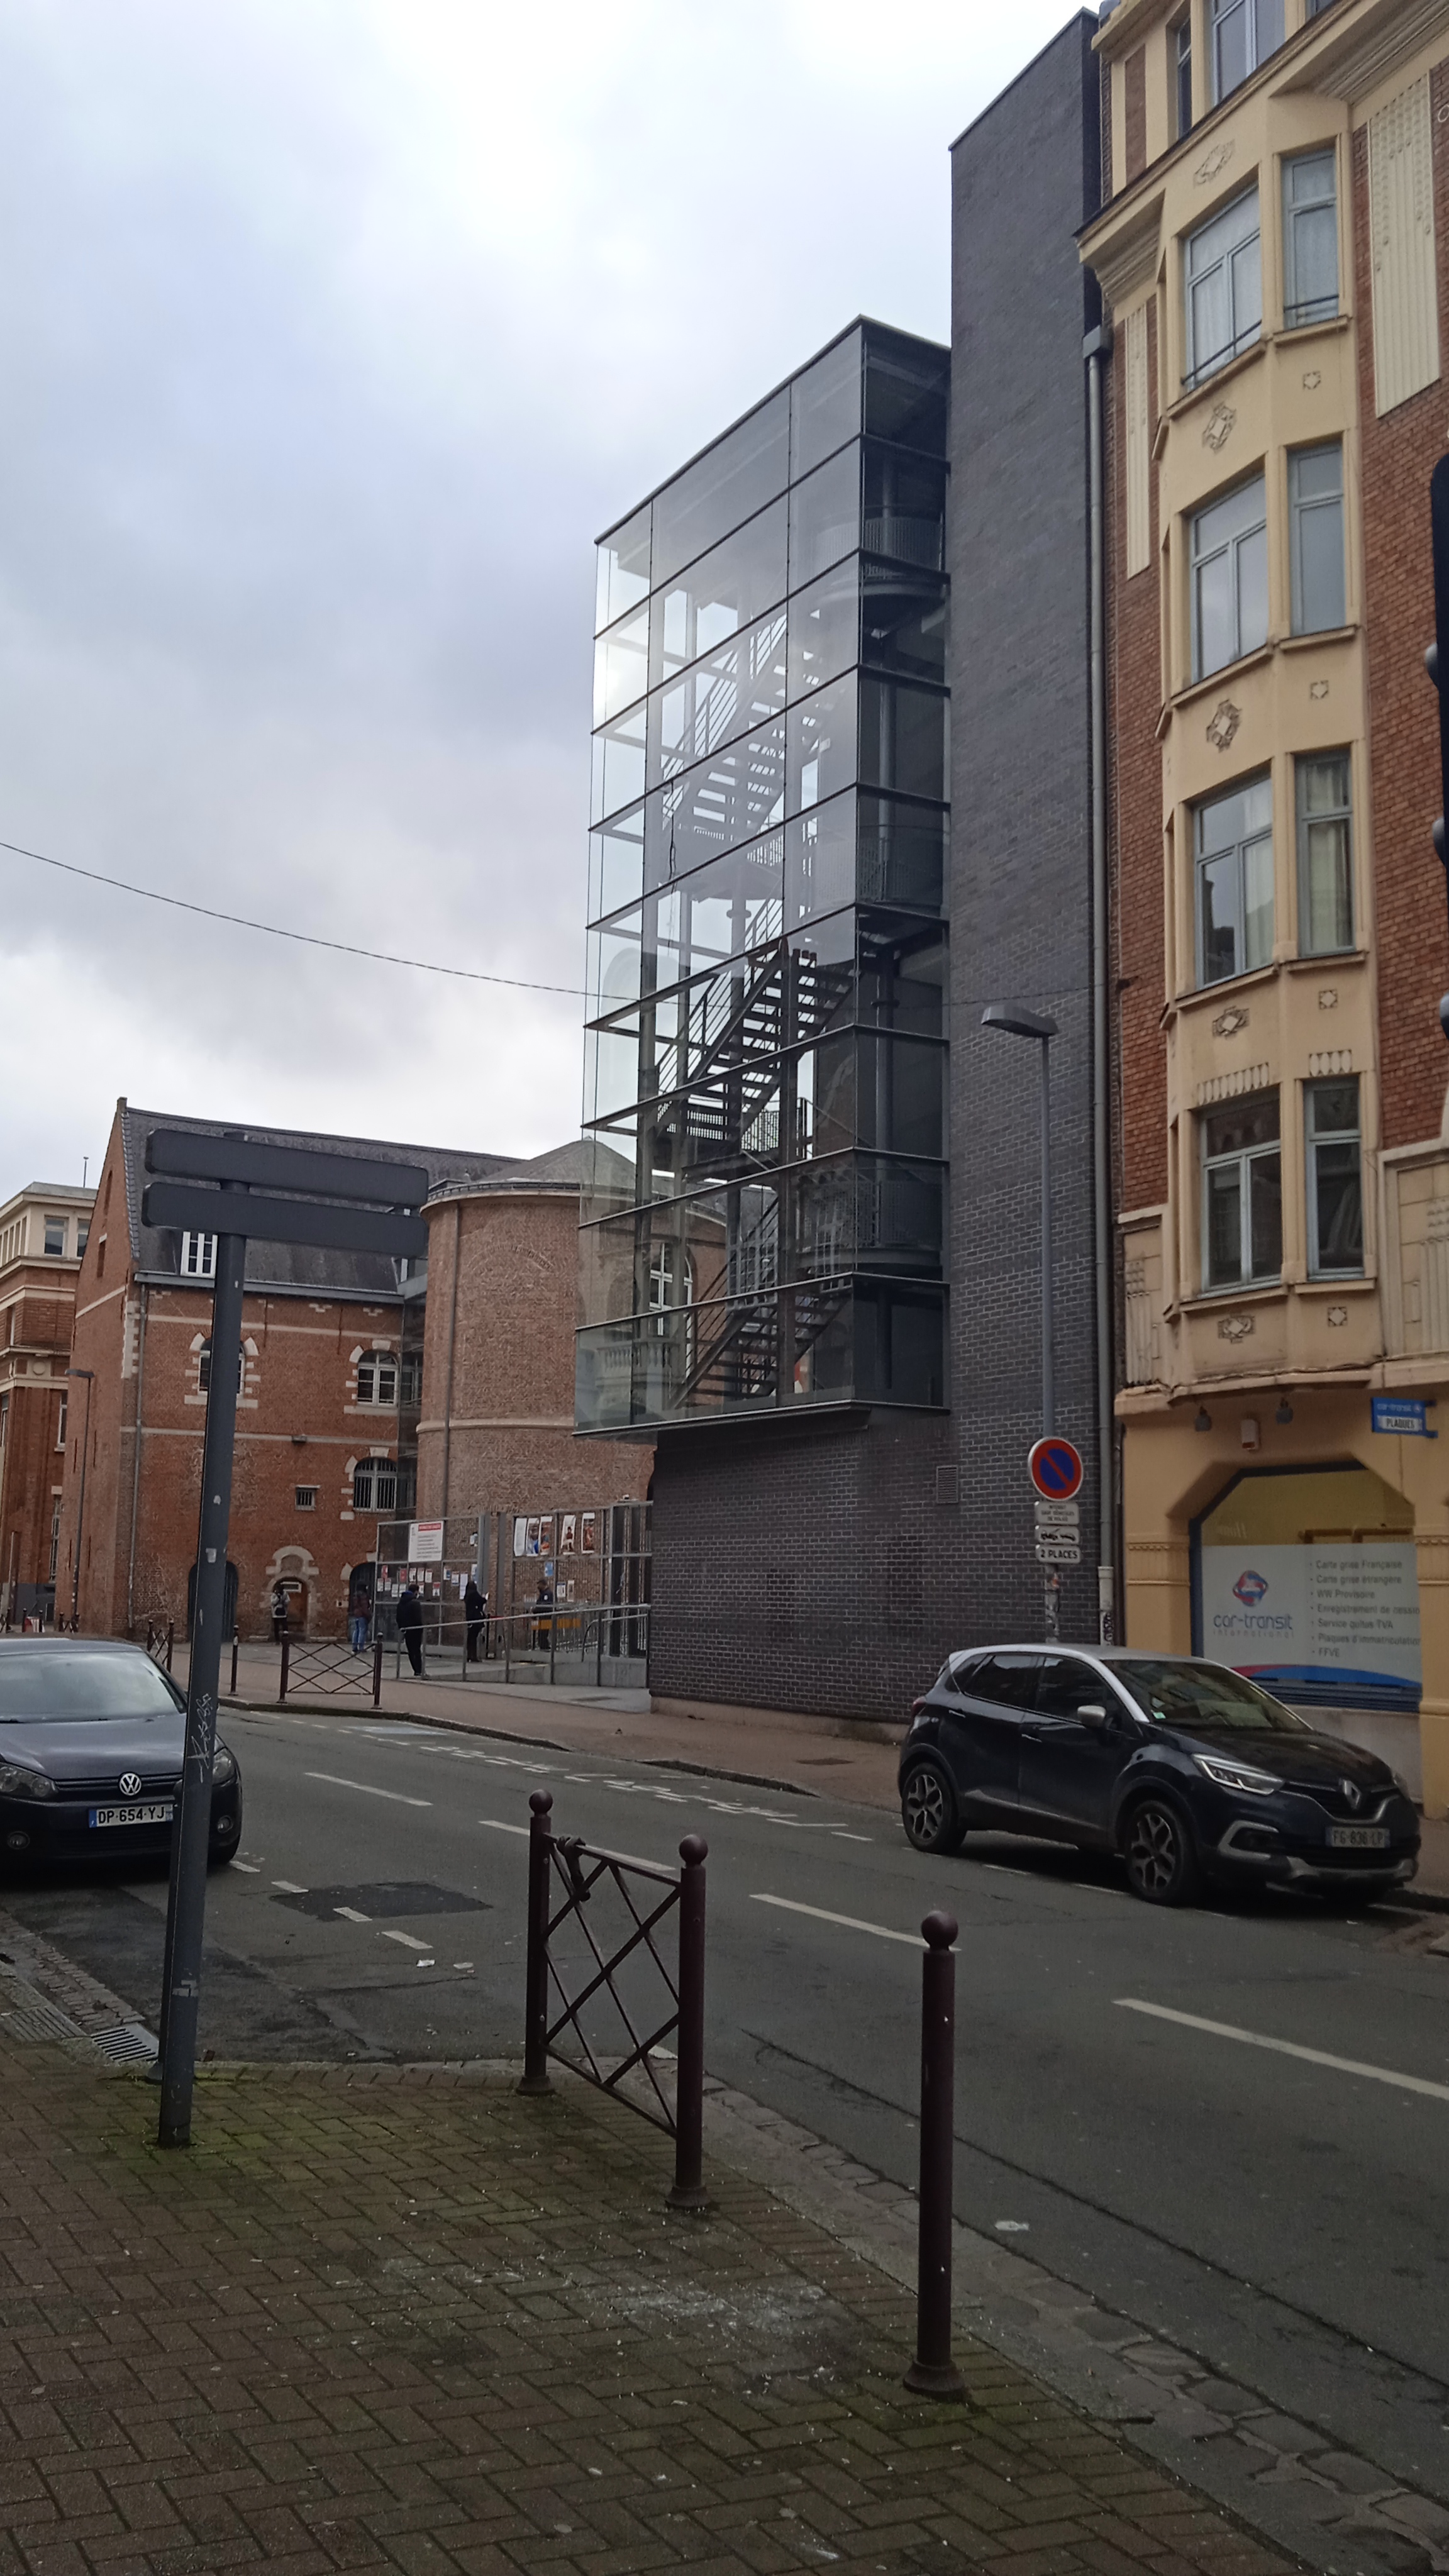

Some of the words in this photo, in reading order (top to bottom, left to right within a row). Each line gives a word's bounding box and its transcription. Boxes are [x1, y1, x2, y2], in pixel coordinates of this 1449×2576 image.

[1387, 1417, 1415, 1430] PLAQUES
[1041, 1549, 1045, 1558] 2
[1048, 1550, 1078, 1559] PLACES
[1316, 1560, 1337, 1570] Carte
[1340, 1561, 1359, 1572] grise
[1362, 1560, 1402, 1571] Française
[1316, 1575, 1338, 1584] Carte
[1340, 1576, 1360, 1585] grise
[1316, 1589, 1333, 1598] WW
[1335, 1589, 1375, 1599] Provisoire
[1318, 1604, 1377, 1616] Enregistrement
[1380, 1606, 1391, 1614] de
[1392, 1606, 1420, 1616] cessio
[1213, 1613, 1293, 1631] car-transit
[1318, 1618, 1347, 1628] Service
[1349, 1619, 1374, 1629] quitus
[1376, 1619, 1394, 1629] TVA
[1213, 1628, 1294, 1639] international
[1318, 1633, 1350, 1644] Plaques
[1318, 1647, 1340, 1658] FFVE
[98, 1806, 165, 1824] DP-654-YJ
